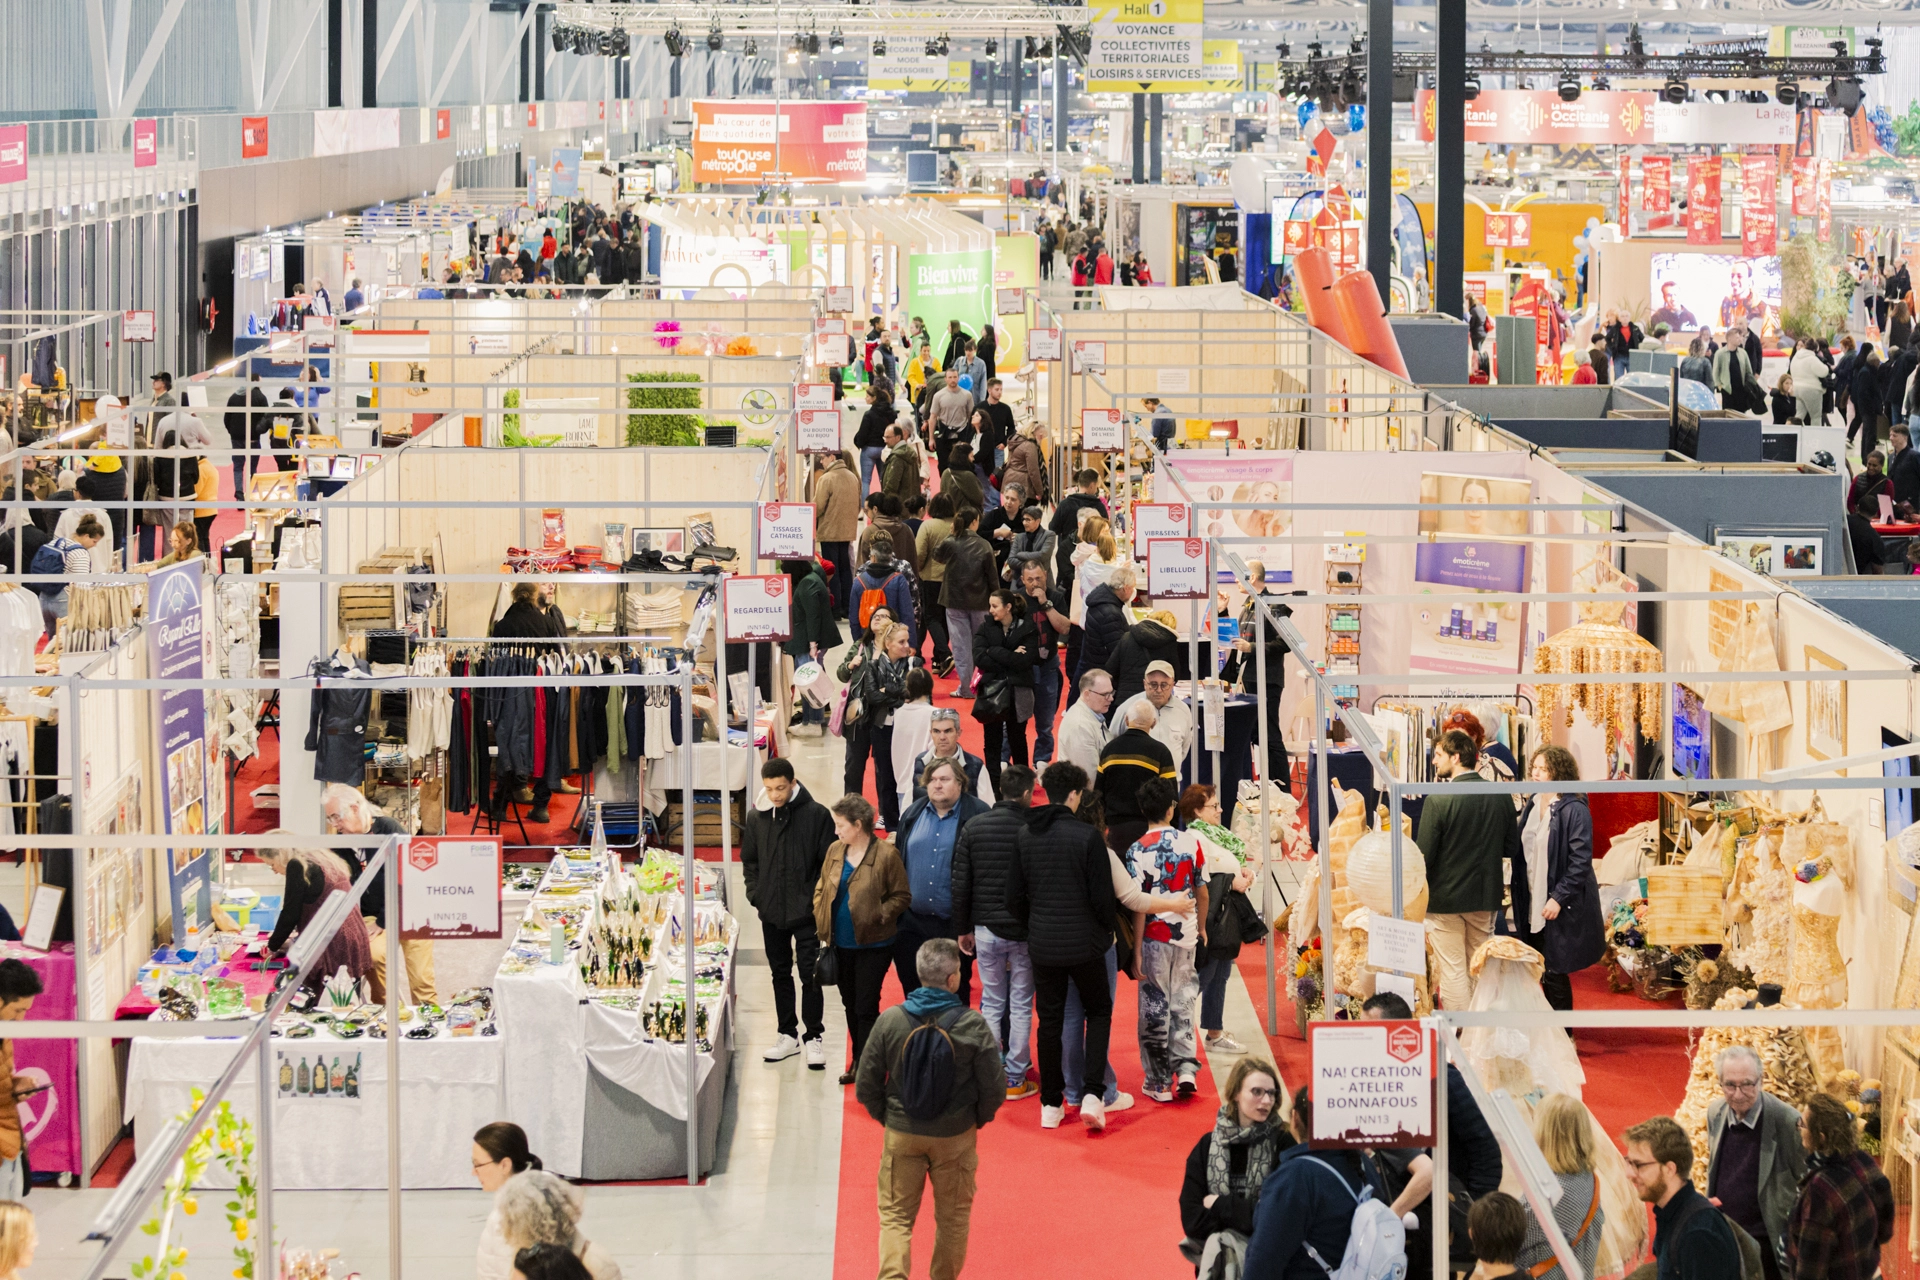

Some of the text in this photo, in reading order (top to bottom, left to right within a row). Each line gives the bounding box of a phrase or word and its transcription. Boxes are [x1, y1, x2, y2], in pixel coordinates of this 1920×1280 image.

[1124, 3, 1161, 15] Hall 1
[1117, 25, 1175, 35] VOYANCE
[886, 45, 926, 53] DÉCORATIO
[1101, 39, 1191, 51] COLLECTIVITÉS
[1101, 53, 1190, 64] TERRITORIALES
[1090, 69, 1201, 79] LOISIRS & SERVICES
[1464, 109, 1498, 122] itanie
[1551, 110, 1610, 123] Occitanie
[1756, 108, 1770, 119] La
[717, 117, 728, 126] Au
[759, 117, 771, 126] de
[723, 130, 771, 139] quotidien
[827, 130, 849, 138] votre
[917, 264, 978, 285] Bien vivre
[565, 431, 595, 442] BORNE
[426, 886, 475, 895] THEONA
[1322, 1066, 1422, 1078] NA! CREATION
[1348, 1082, 1404, 1093] ATELIER
[1327, 1096, 1418, 1109] BONNAFOUS
[1355, 1115, 1390, 1124] INN13
